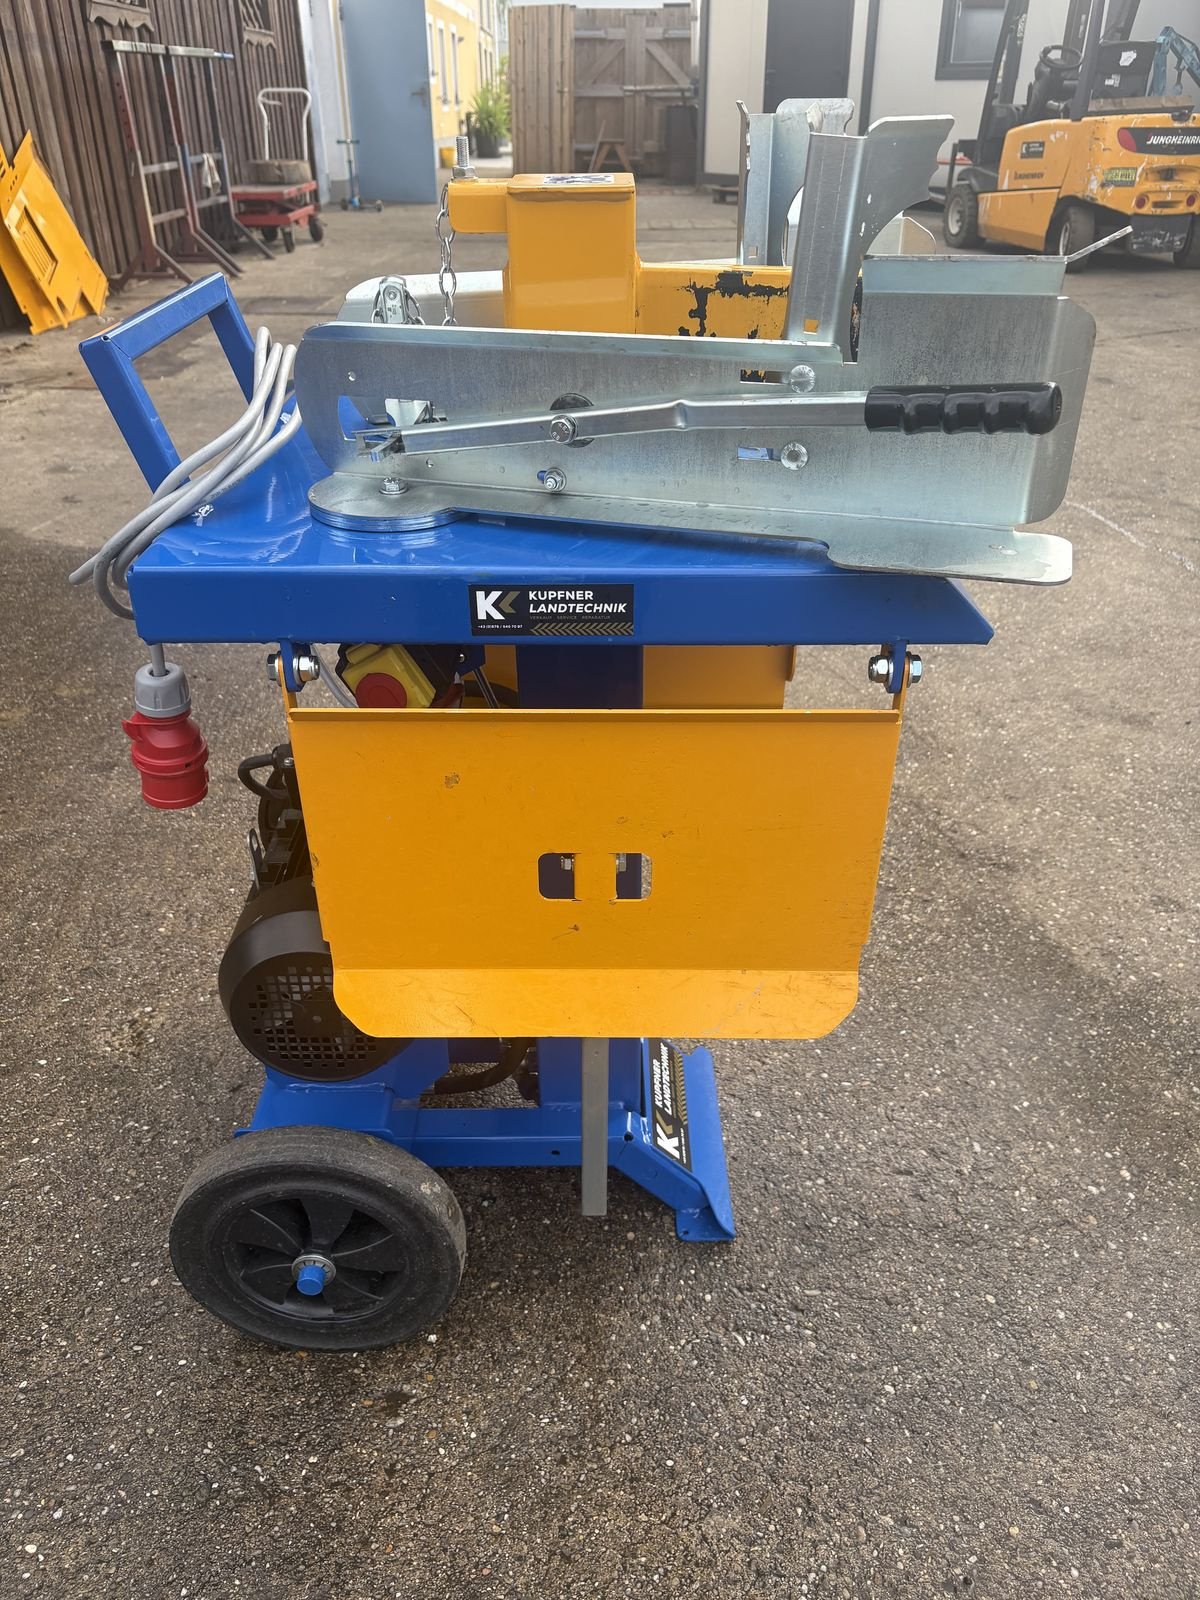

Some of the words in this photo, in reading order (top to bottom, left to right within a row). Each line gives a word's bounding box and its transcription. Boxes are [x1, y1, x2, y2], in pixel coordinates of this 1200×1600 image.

[528, 590, 594, 601] KUPFNER
[529, 603, 628, 613] LANDTECHNIK
[652, 1059, 663, 1108] KUPFNER
[660, 1042, 673, 1116] LANDTECHNIK
